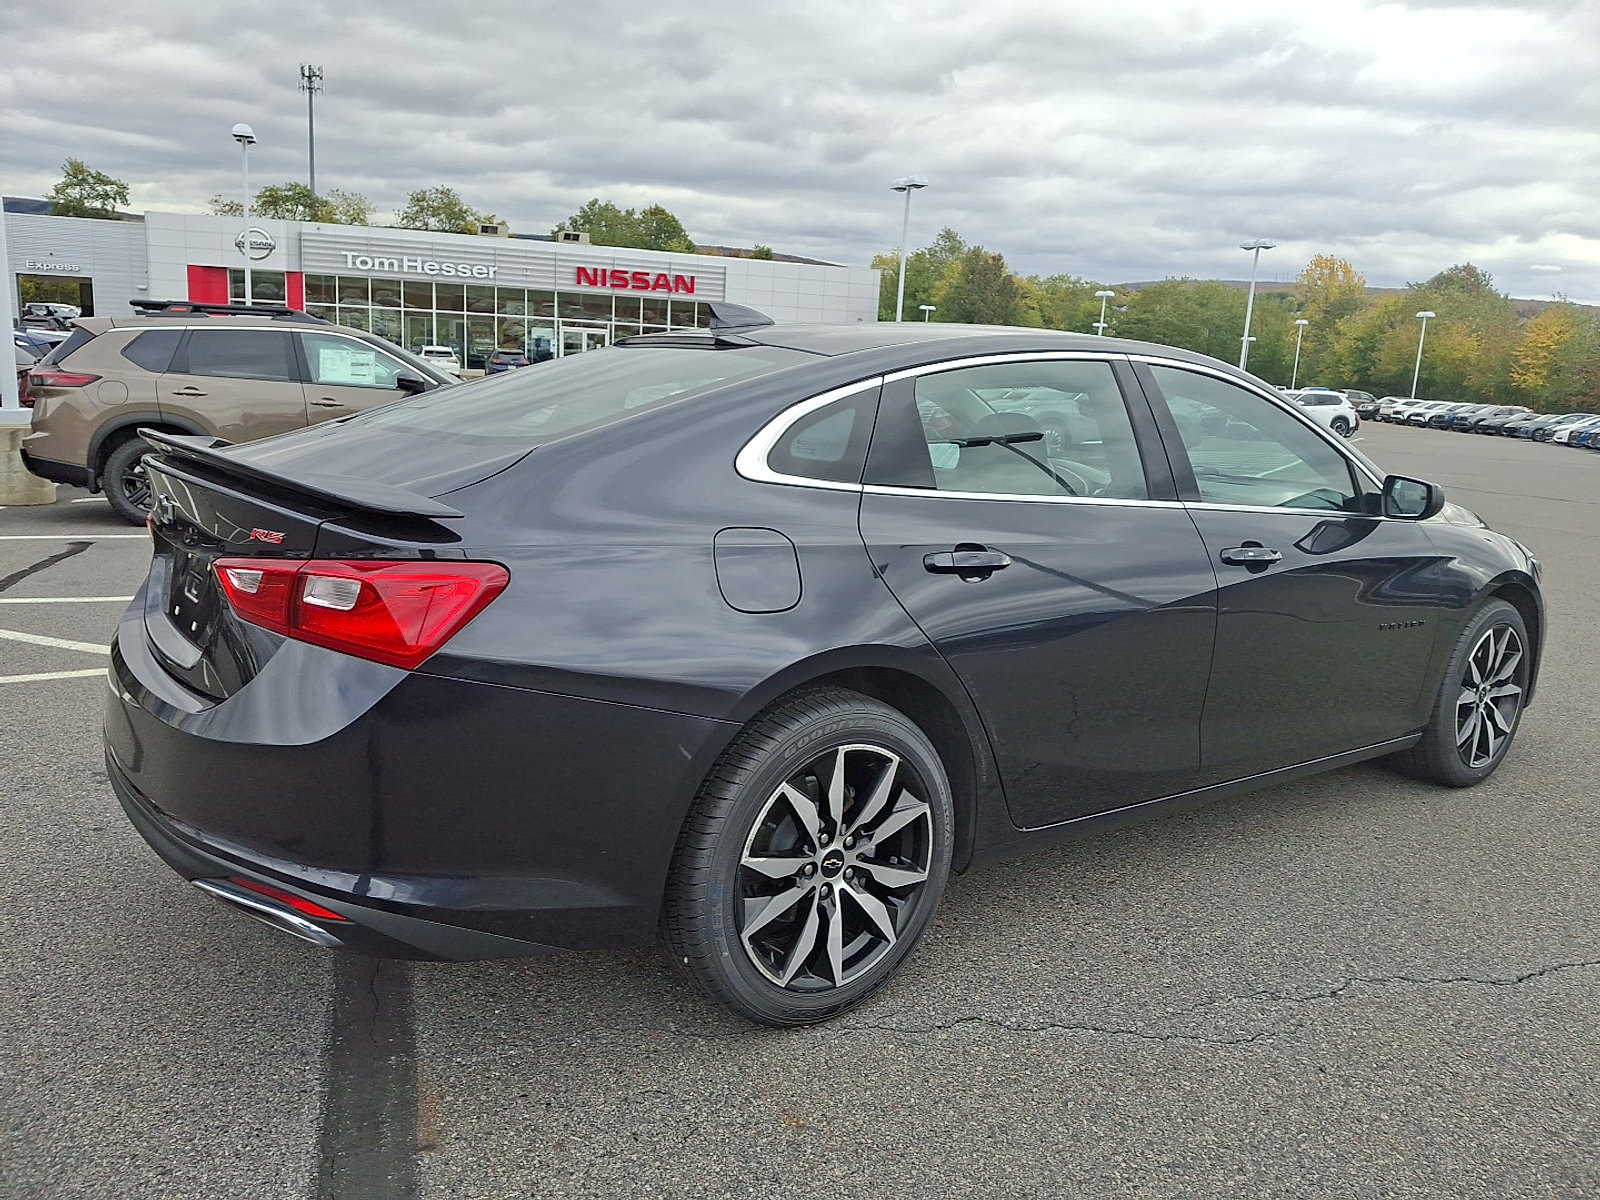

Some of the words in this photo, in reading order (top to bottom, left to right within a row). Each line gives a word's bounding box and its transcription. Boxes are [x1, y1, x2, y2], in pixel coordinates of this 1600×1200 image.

[25, 259, 80, 272] Express
[341, 251, 399, 272] Tom
[403, 255, 498, 279] Hesser
[576, 266, 696, 294] NISSAN
[249, 527, 287, 544] RS
